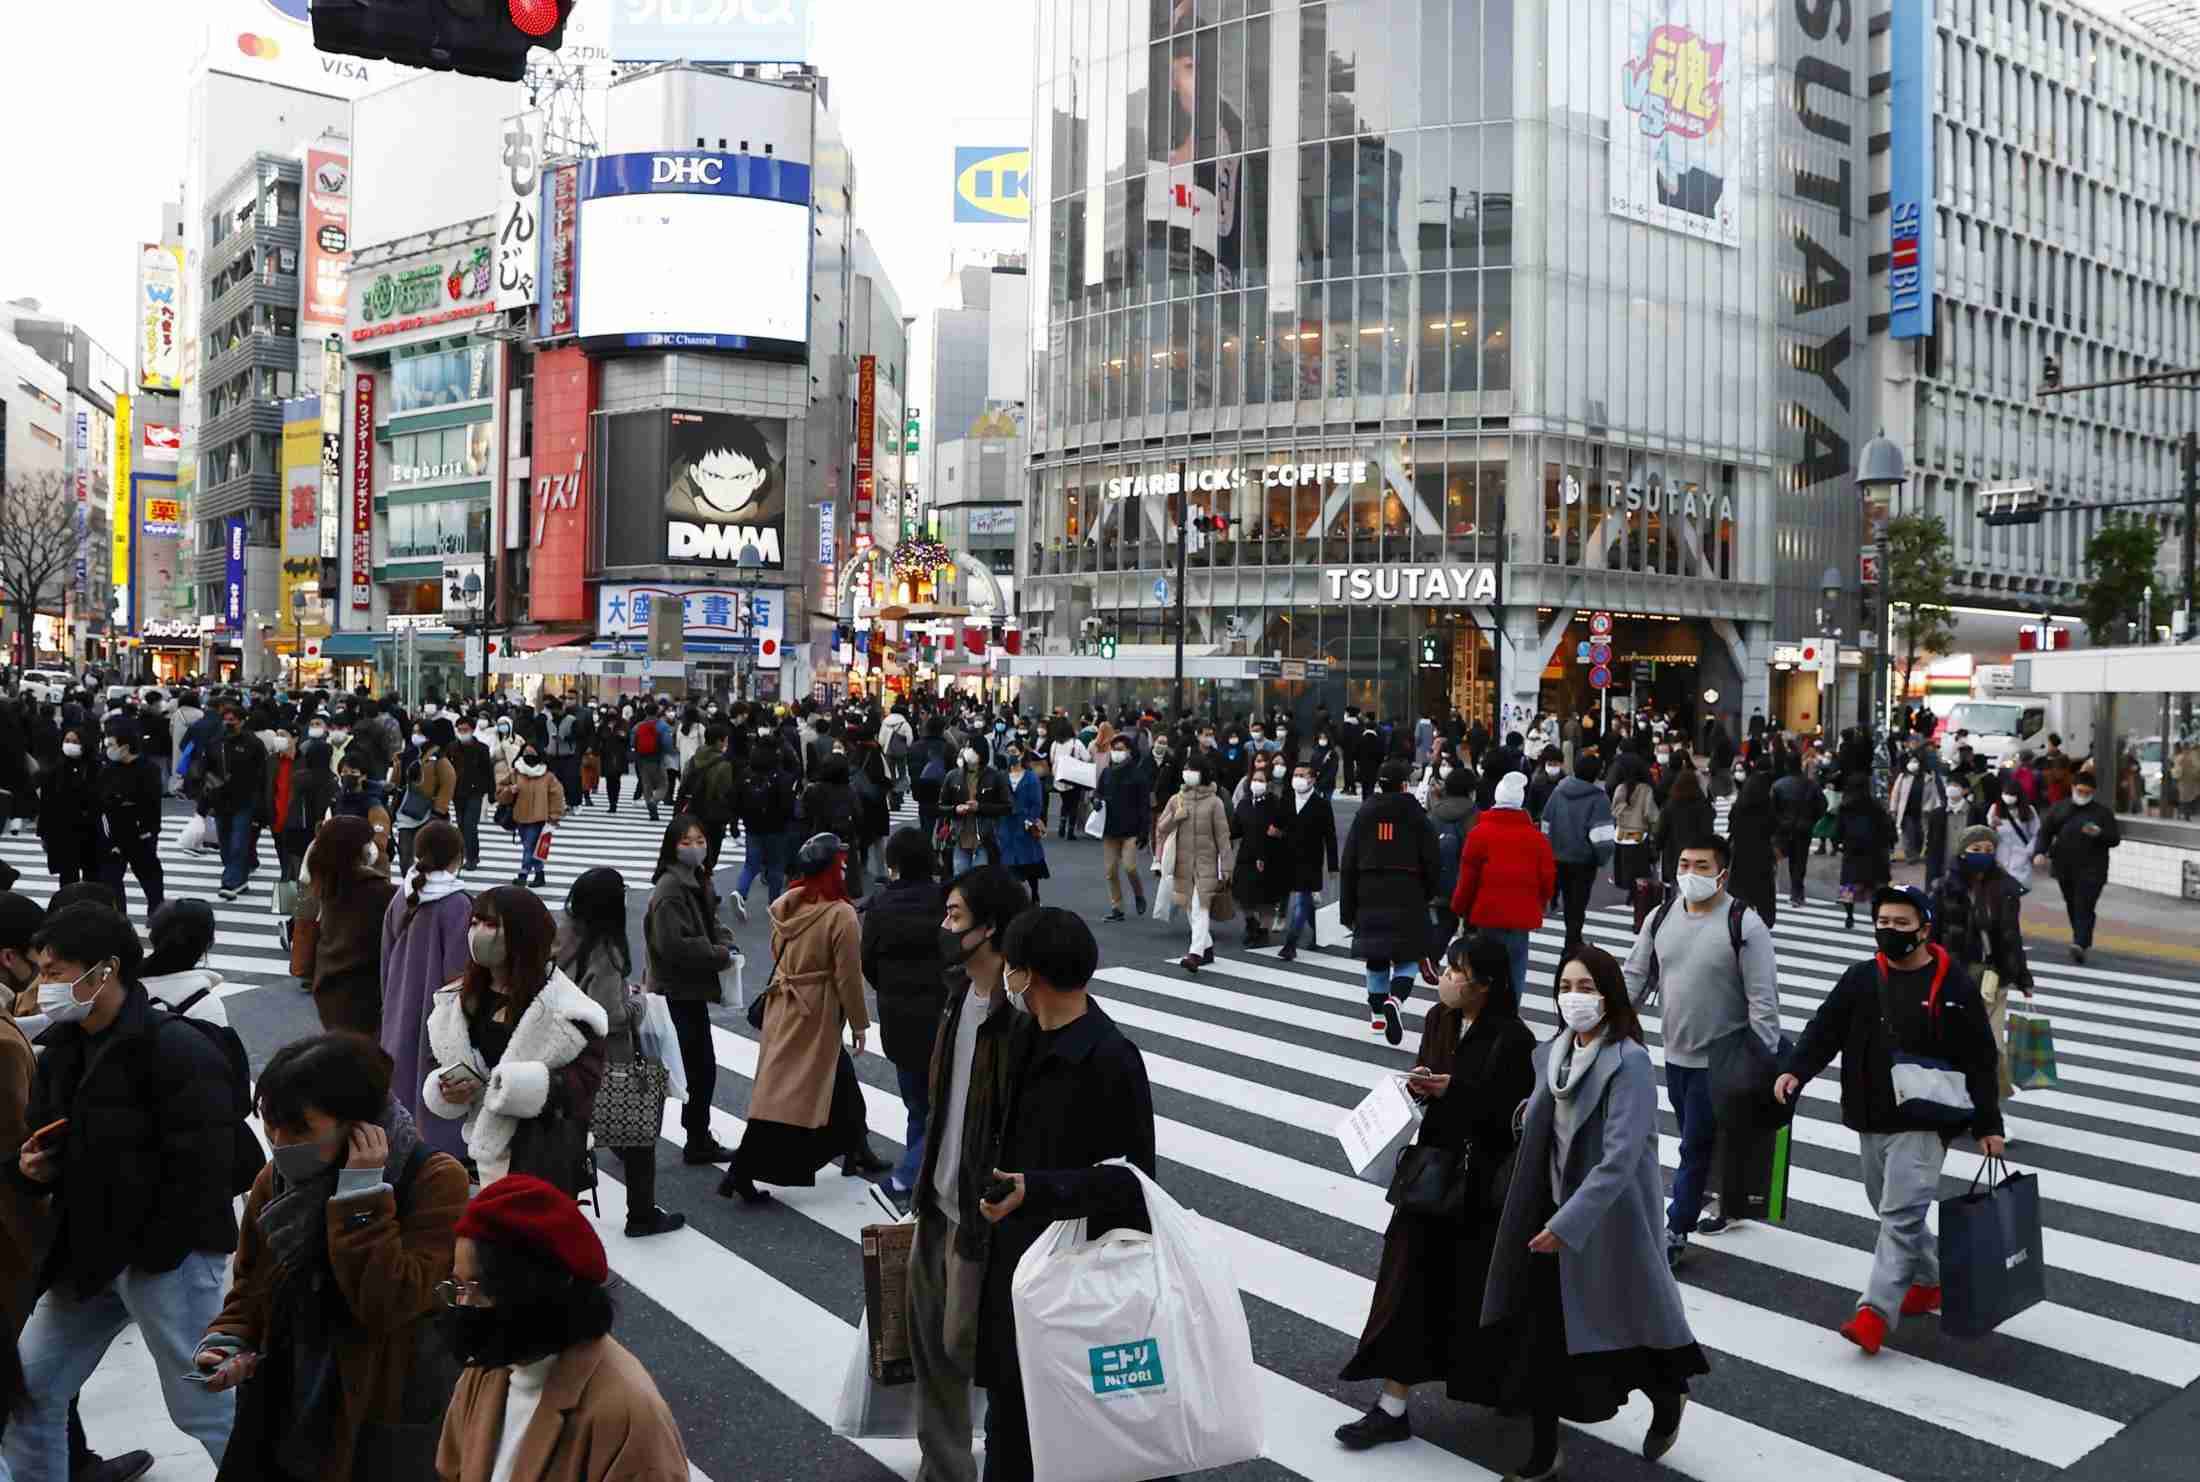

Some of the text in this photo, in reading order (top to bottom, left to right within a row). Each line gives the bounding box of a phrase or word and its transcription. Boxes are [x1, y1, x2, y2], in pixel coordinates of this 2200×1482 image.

[321, 57, 369, 81] VISA
[651, 157, 723, 185] DHC
[499, 116, 537, 301] もんじゃ
[1892, 201, 1920, 315] SEIBU
[652, 334, 716, 346] DHC Channel
[392, 460, 463, 483] Euphoria
[1108, 460, 1367, 500] STARBUCKS COFFEE
[535, 451, 584, 549] クスリ
[1607, 479, 1734, 522] TSUTAYA
[667, 520, 781, 563] DMM
[1326, 568, 1497, 601] TSUTAYA
[607, 592, 771, 628] 大盛書店
[1102, 1345, 1149, 1370] ニトリ
[1104, 1369, 1153, 1387] NITORI
